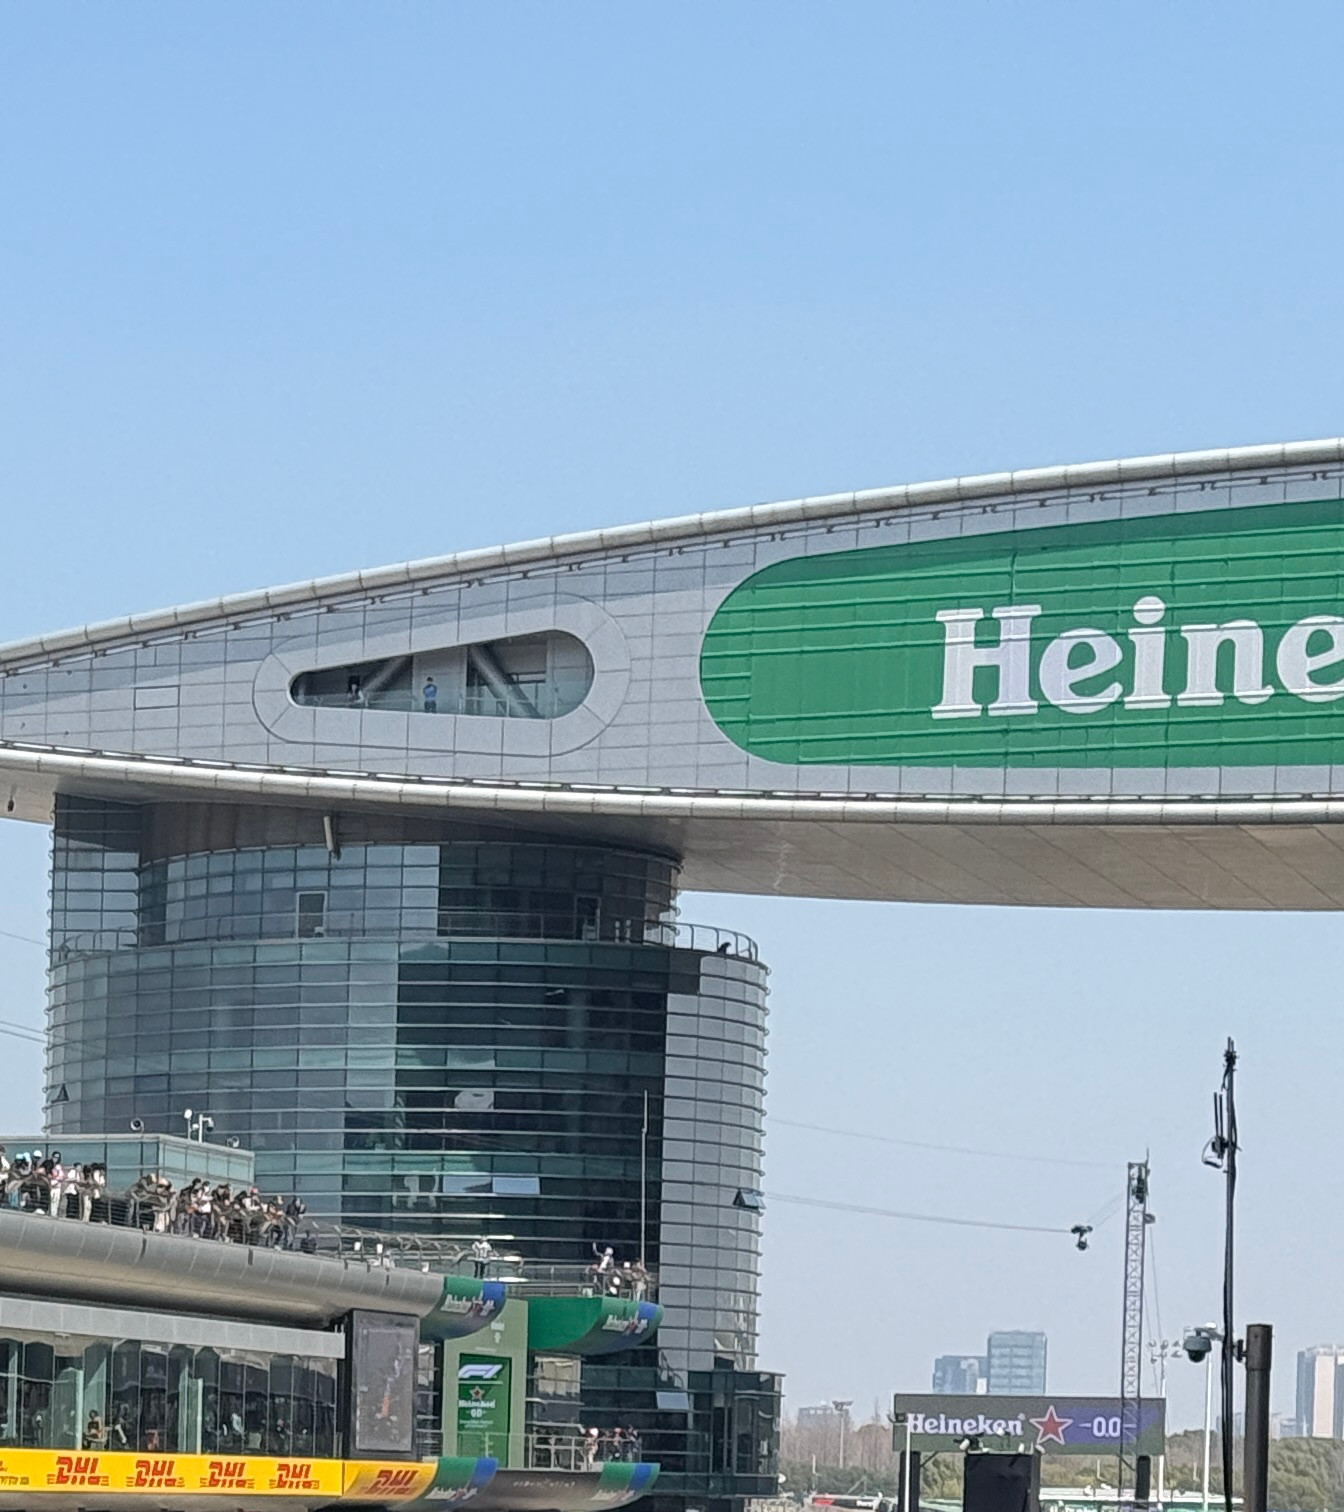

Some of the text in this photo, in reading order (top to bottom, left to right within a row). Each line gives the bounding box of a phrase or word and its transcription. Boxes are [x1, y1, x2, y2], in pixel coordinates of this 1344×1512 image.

[55, 1456, 101, 1486] DHL
[135, 1459, 176, 1488] DHL
[208, 1461, 247, 1488] DHL
[276, 1463, 313, 1490] DHL
